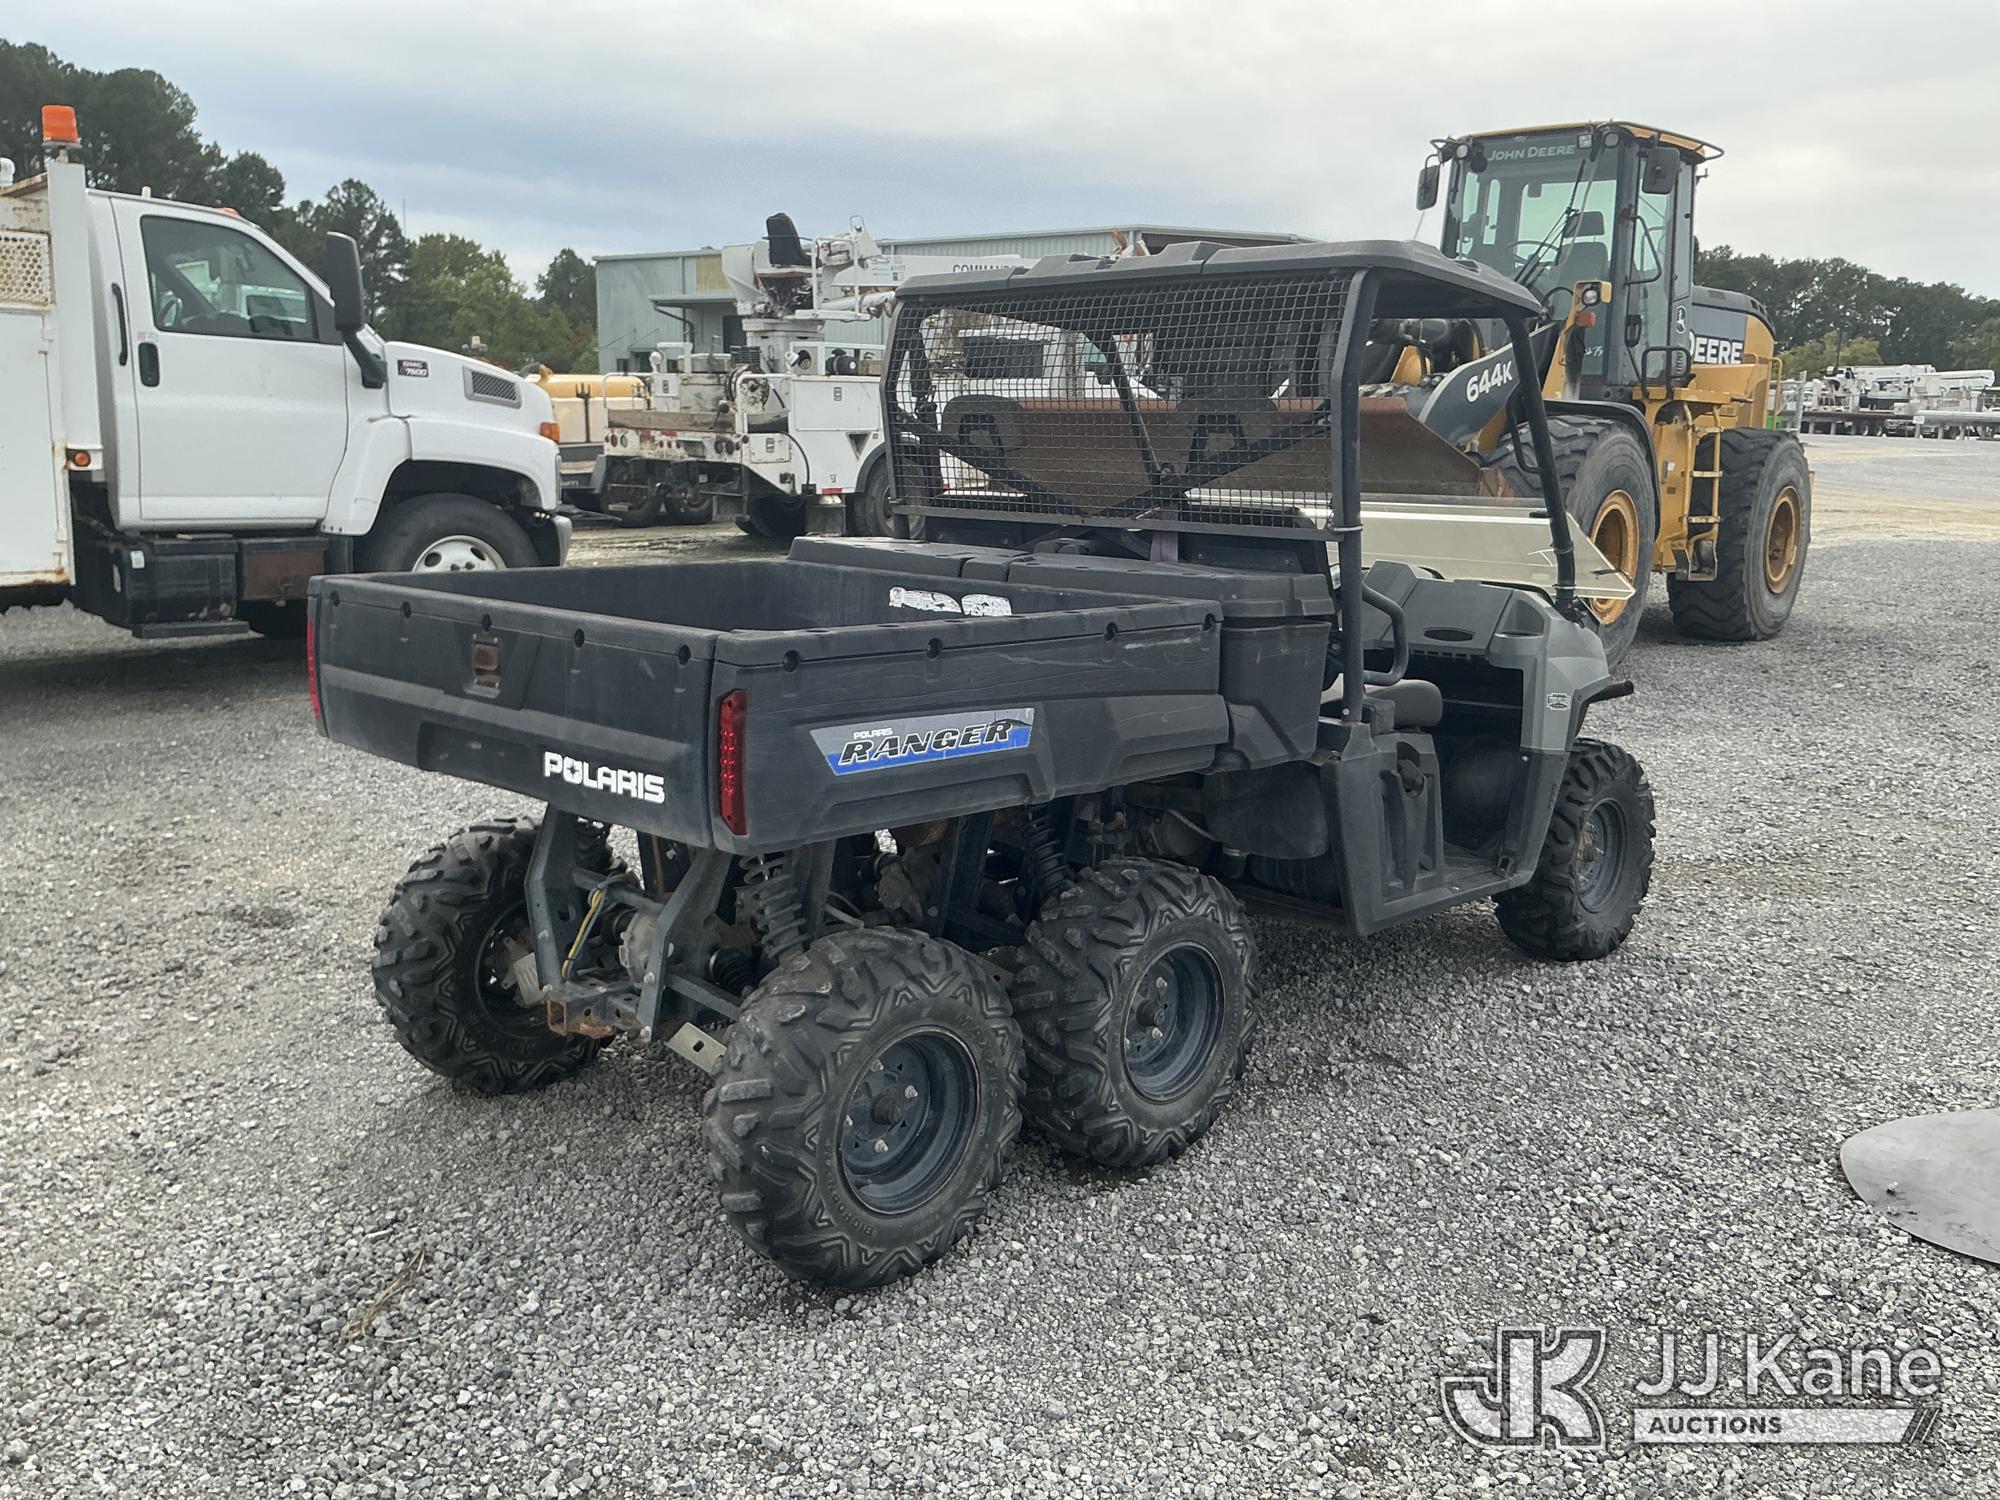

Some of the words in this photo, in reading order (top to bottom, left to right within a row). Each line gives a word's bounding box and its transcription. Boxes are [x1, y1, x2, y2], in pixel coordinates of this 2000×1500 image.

[1487, 149, 1525, 161] JOHN
[1527, 144, 1577, 158] DEERE
[1466, 360, 1513, 402] 644K
[838, 721, 1013, 766] RANGER
[853, 727, 893, 740] POLARIS
[544, 751, 665, 804] POLARIS
